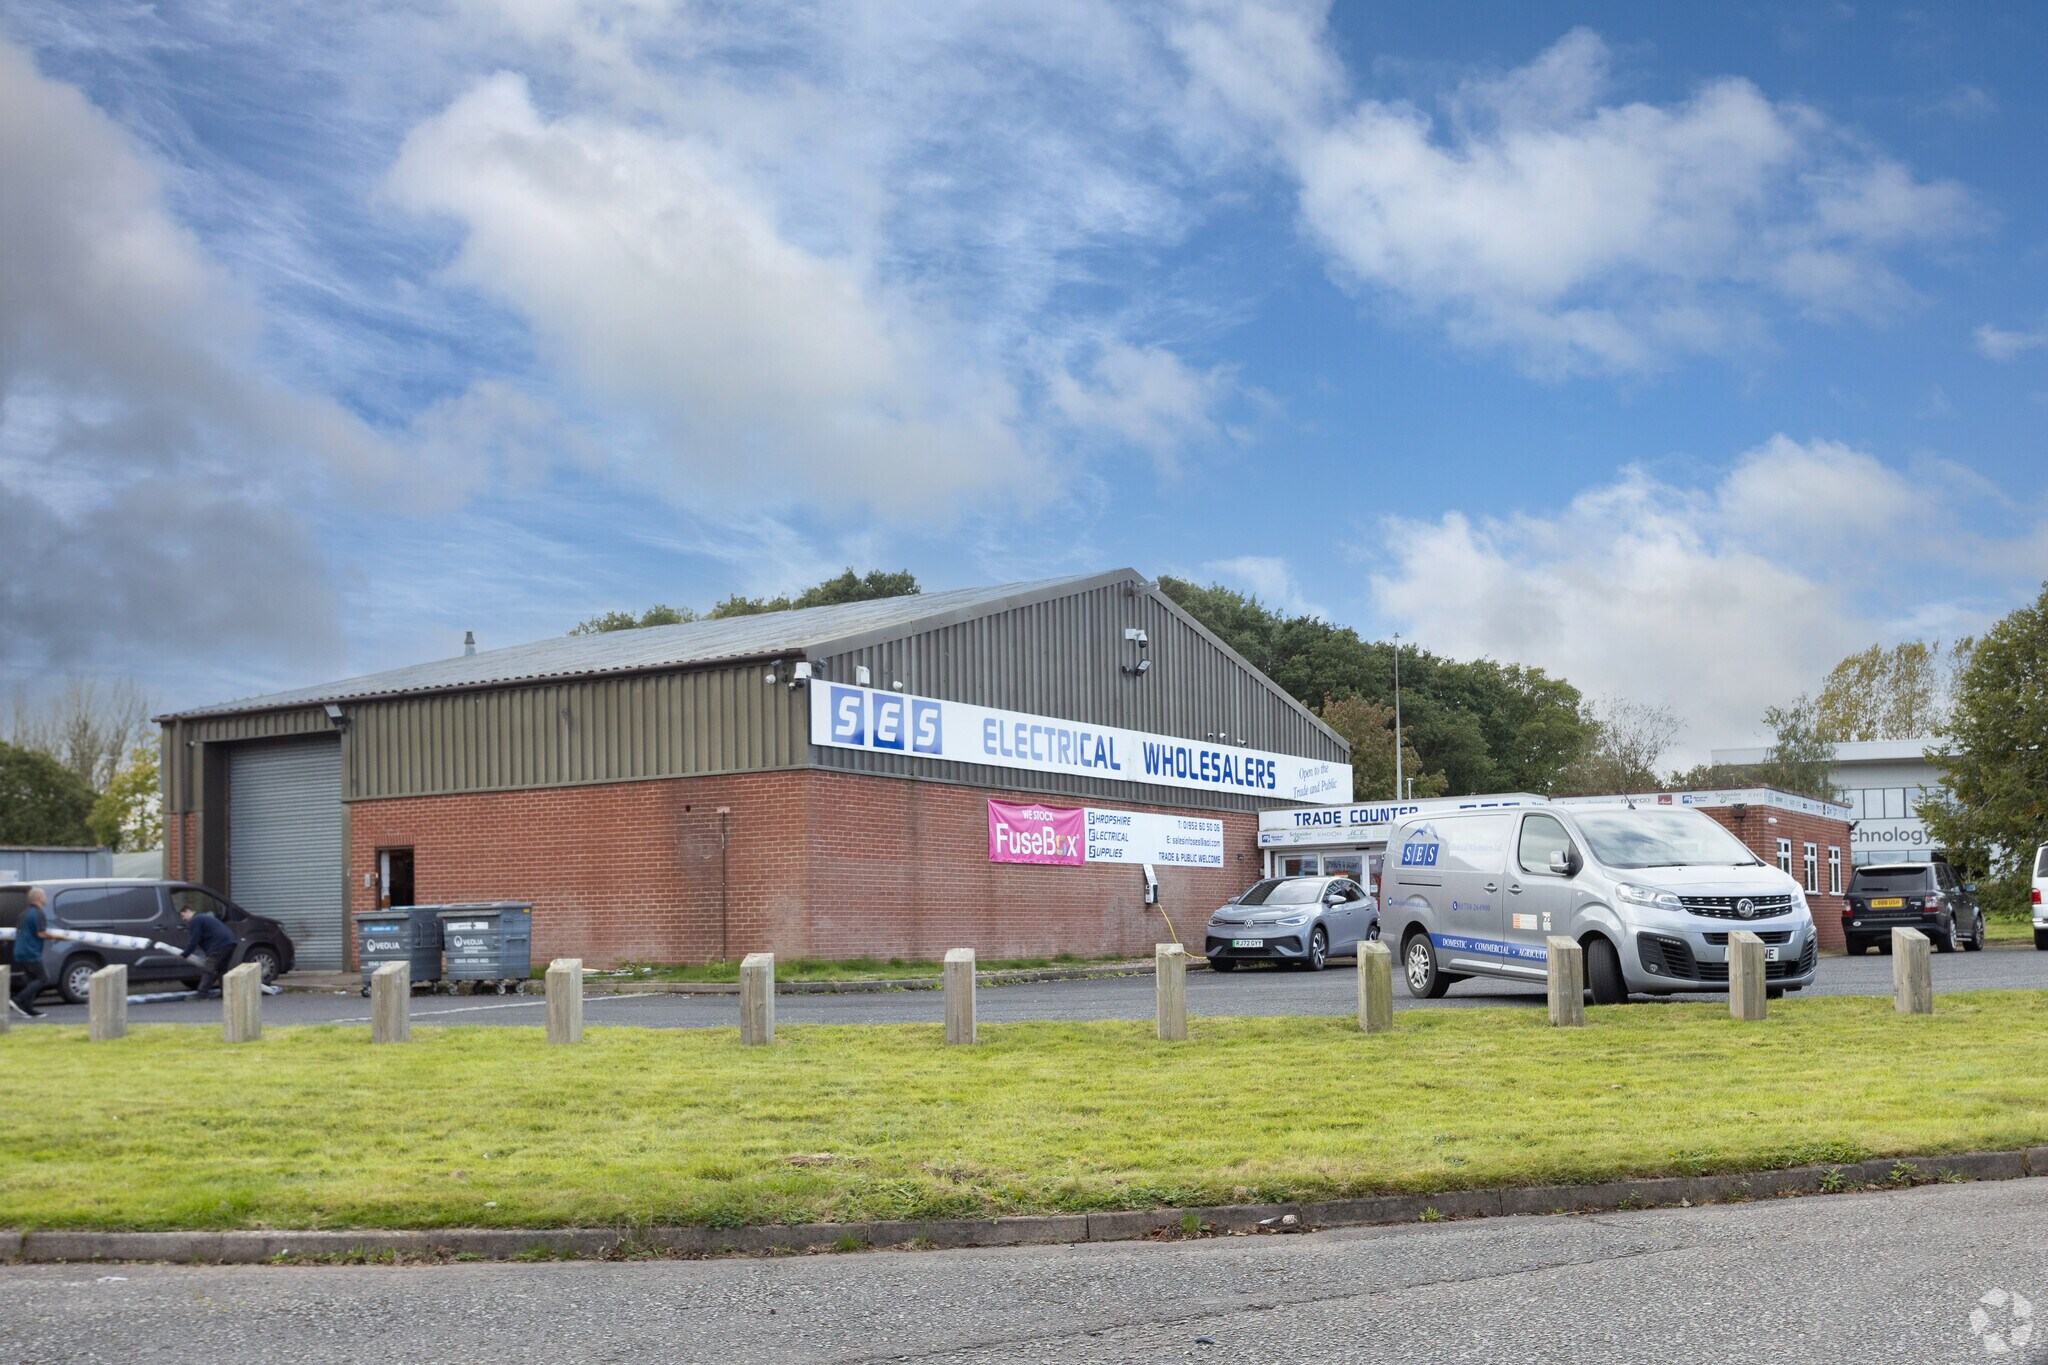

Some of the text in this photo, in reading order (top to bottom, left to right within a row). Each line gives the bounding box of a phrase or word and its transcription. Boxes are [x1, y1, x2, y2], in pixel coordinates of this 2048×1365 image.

[834, 694, 940, 749] SES
[983, 718, 1276, 790] ELECTRICAL WHOLESALERS
[1299, 763, 1328, 781] Open to the
[1293, 778, 1337, 798] Trade and Public
[1022, 809, 1054, 822] WE STOCK
[1088, 812, 1131, 826] SHROPSHIRE
[1294, 807, 1418, 827] TRADE COUNTER
[996, 823, 1077, 857] FuseBox
[1088, 829, 1129, 842] ELECTRICAL
[1089, 845, 1123, 858] SUPPLIES
[1158, 852, 1175, 861] TRADE
[1181, 853, 1197, 863] PUBLIC
[1198, 854, 1221, 864] WELCOME
[1403, 845, 1437, 863] SES
[375, 942, 400, 950] VEOLIA
[462, 938, 484, 946] VEOLIA
[1442, 938, 1467, 949] DOMESTIC
[1475, 942, 1509, 955] COMMERCIAL
